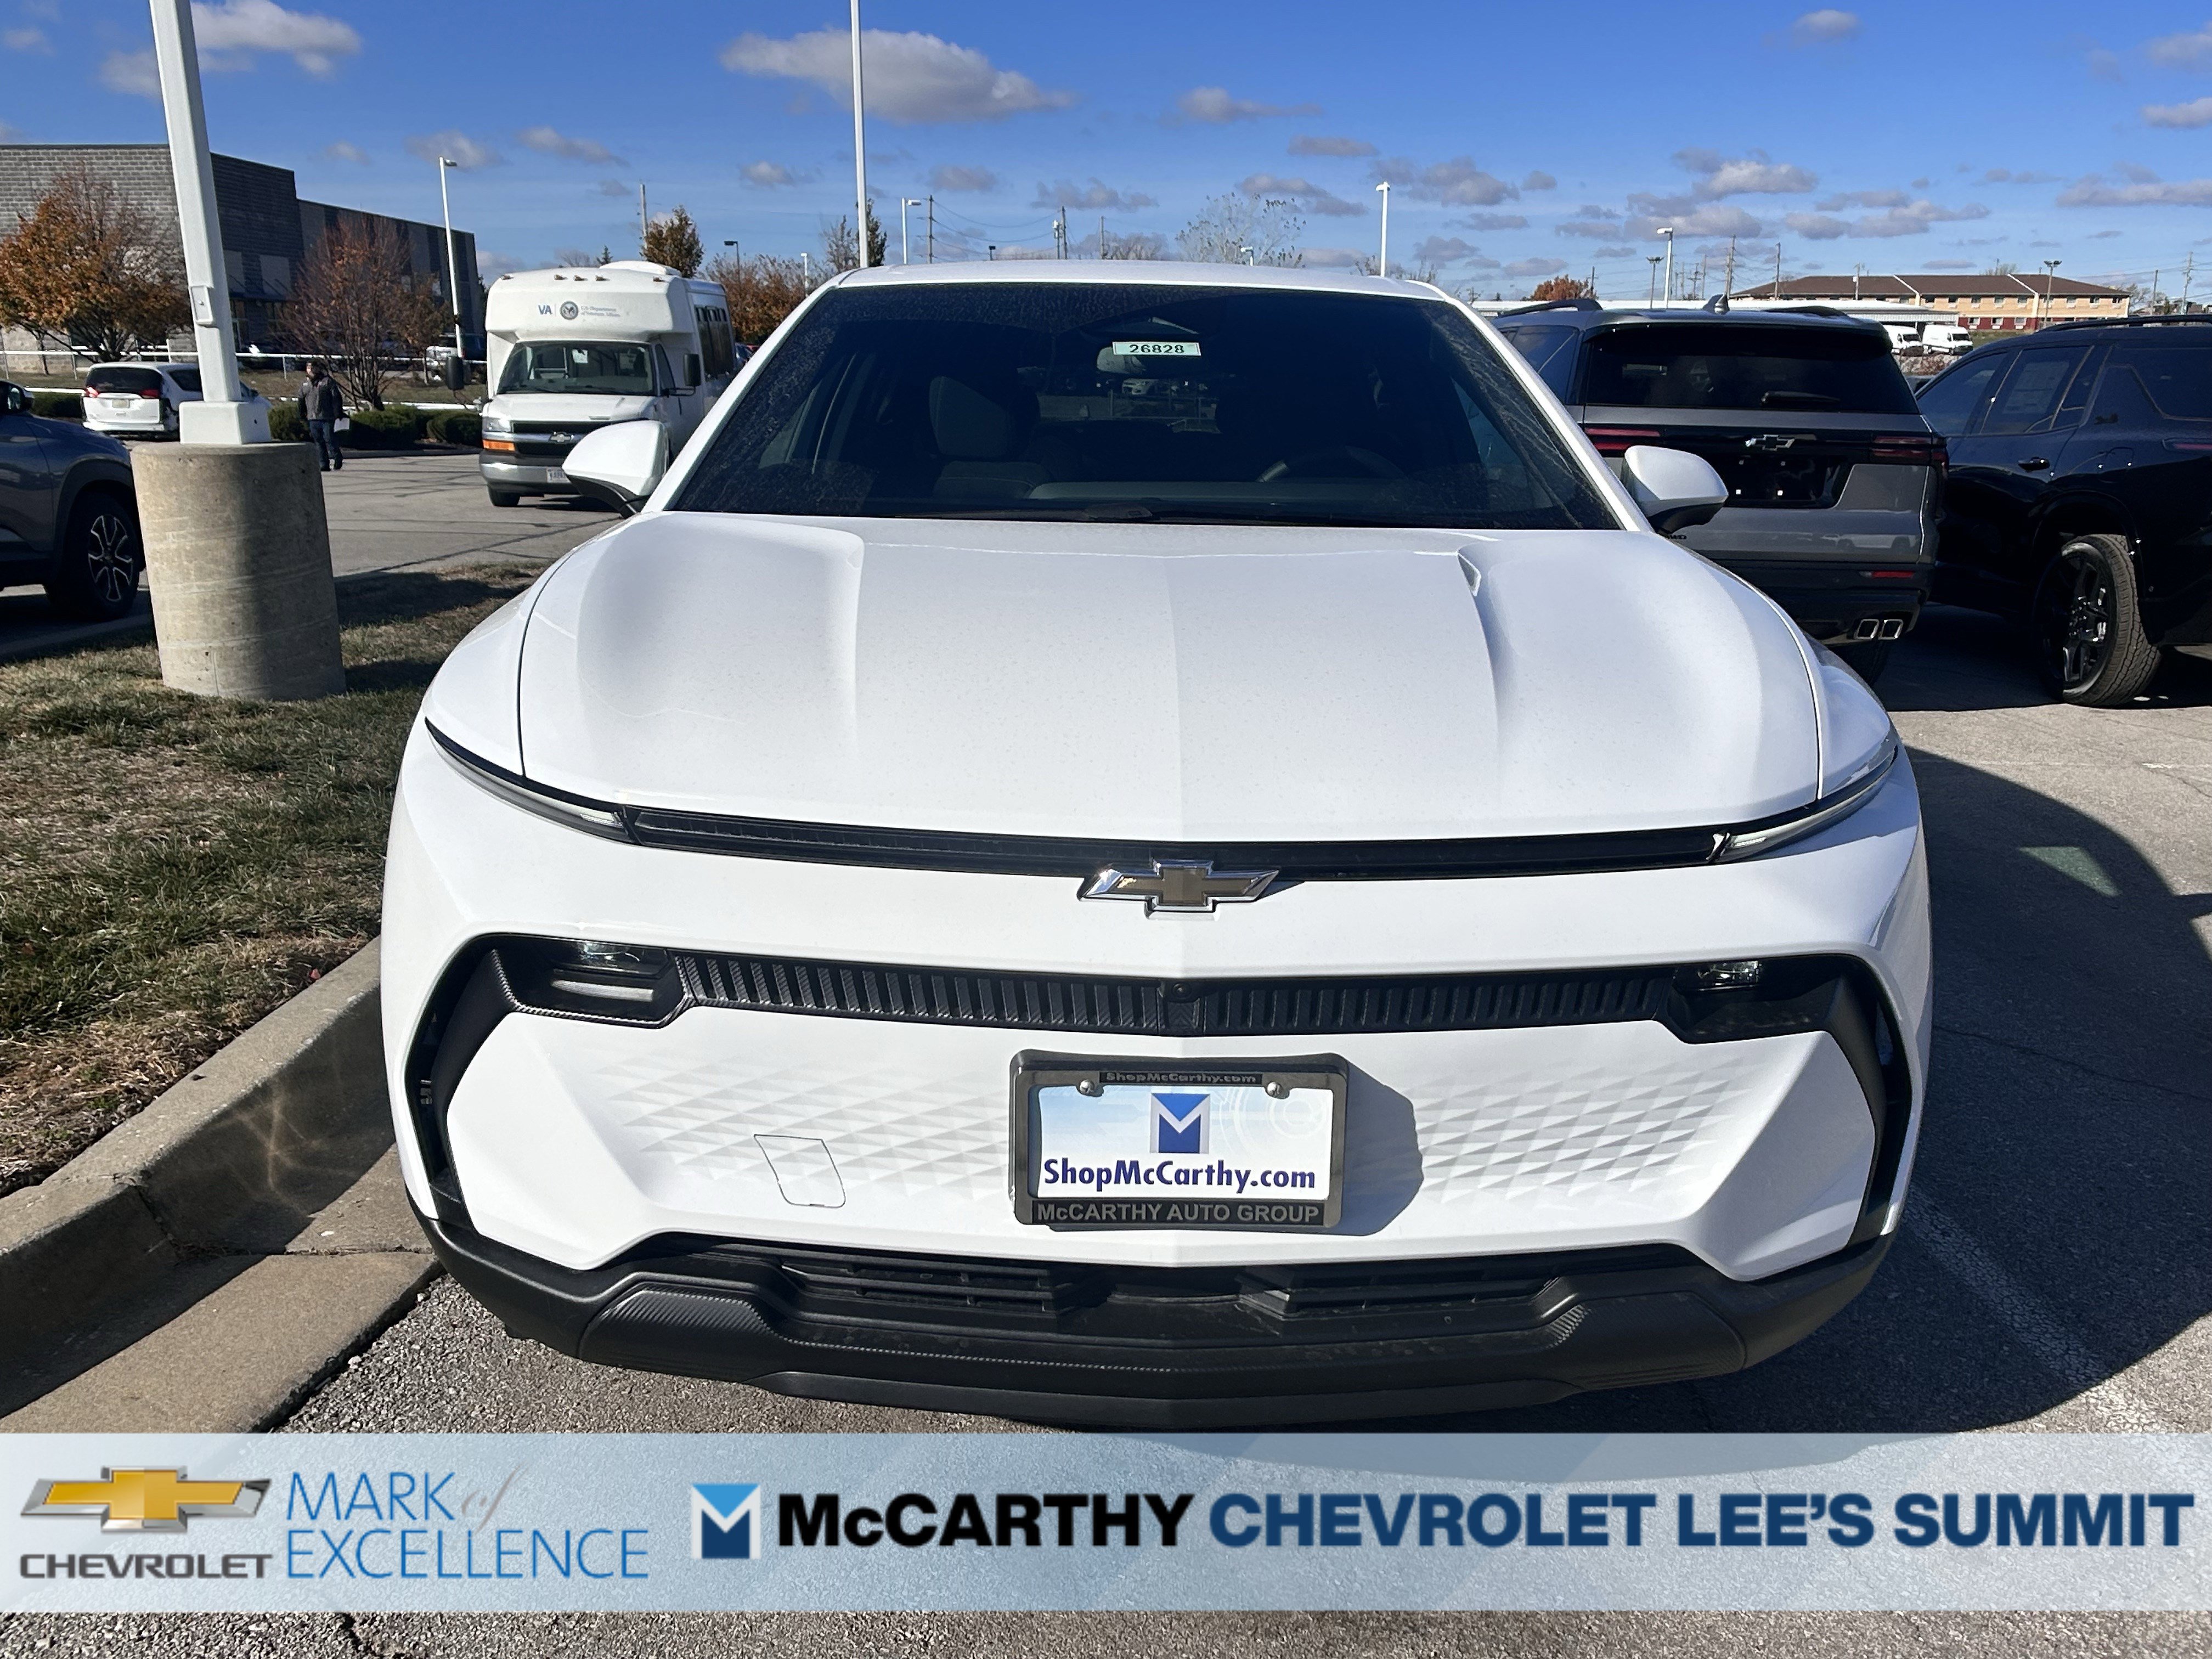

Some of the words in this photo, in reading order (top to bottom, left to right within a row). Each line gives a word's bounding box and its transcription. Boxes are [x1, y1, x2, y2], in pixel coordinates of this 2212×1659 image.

[538, 305, 552, 315] VA
[1130, 344, 1184, 353] 26828
[1106, 1072, 1256, 1083] ShopMcCarthy.com
[1044, 1158, 1315, 1193] ShopMcCarthy.com
[1037, 1201, 1163, 1221] McCARTHY
[1166, 1204, 1231, 1221] AUTO
[1237, 1204, 1319, 1222] GROUP
